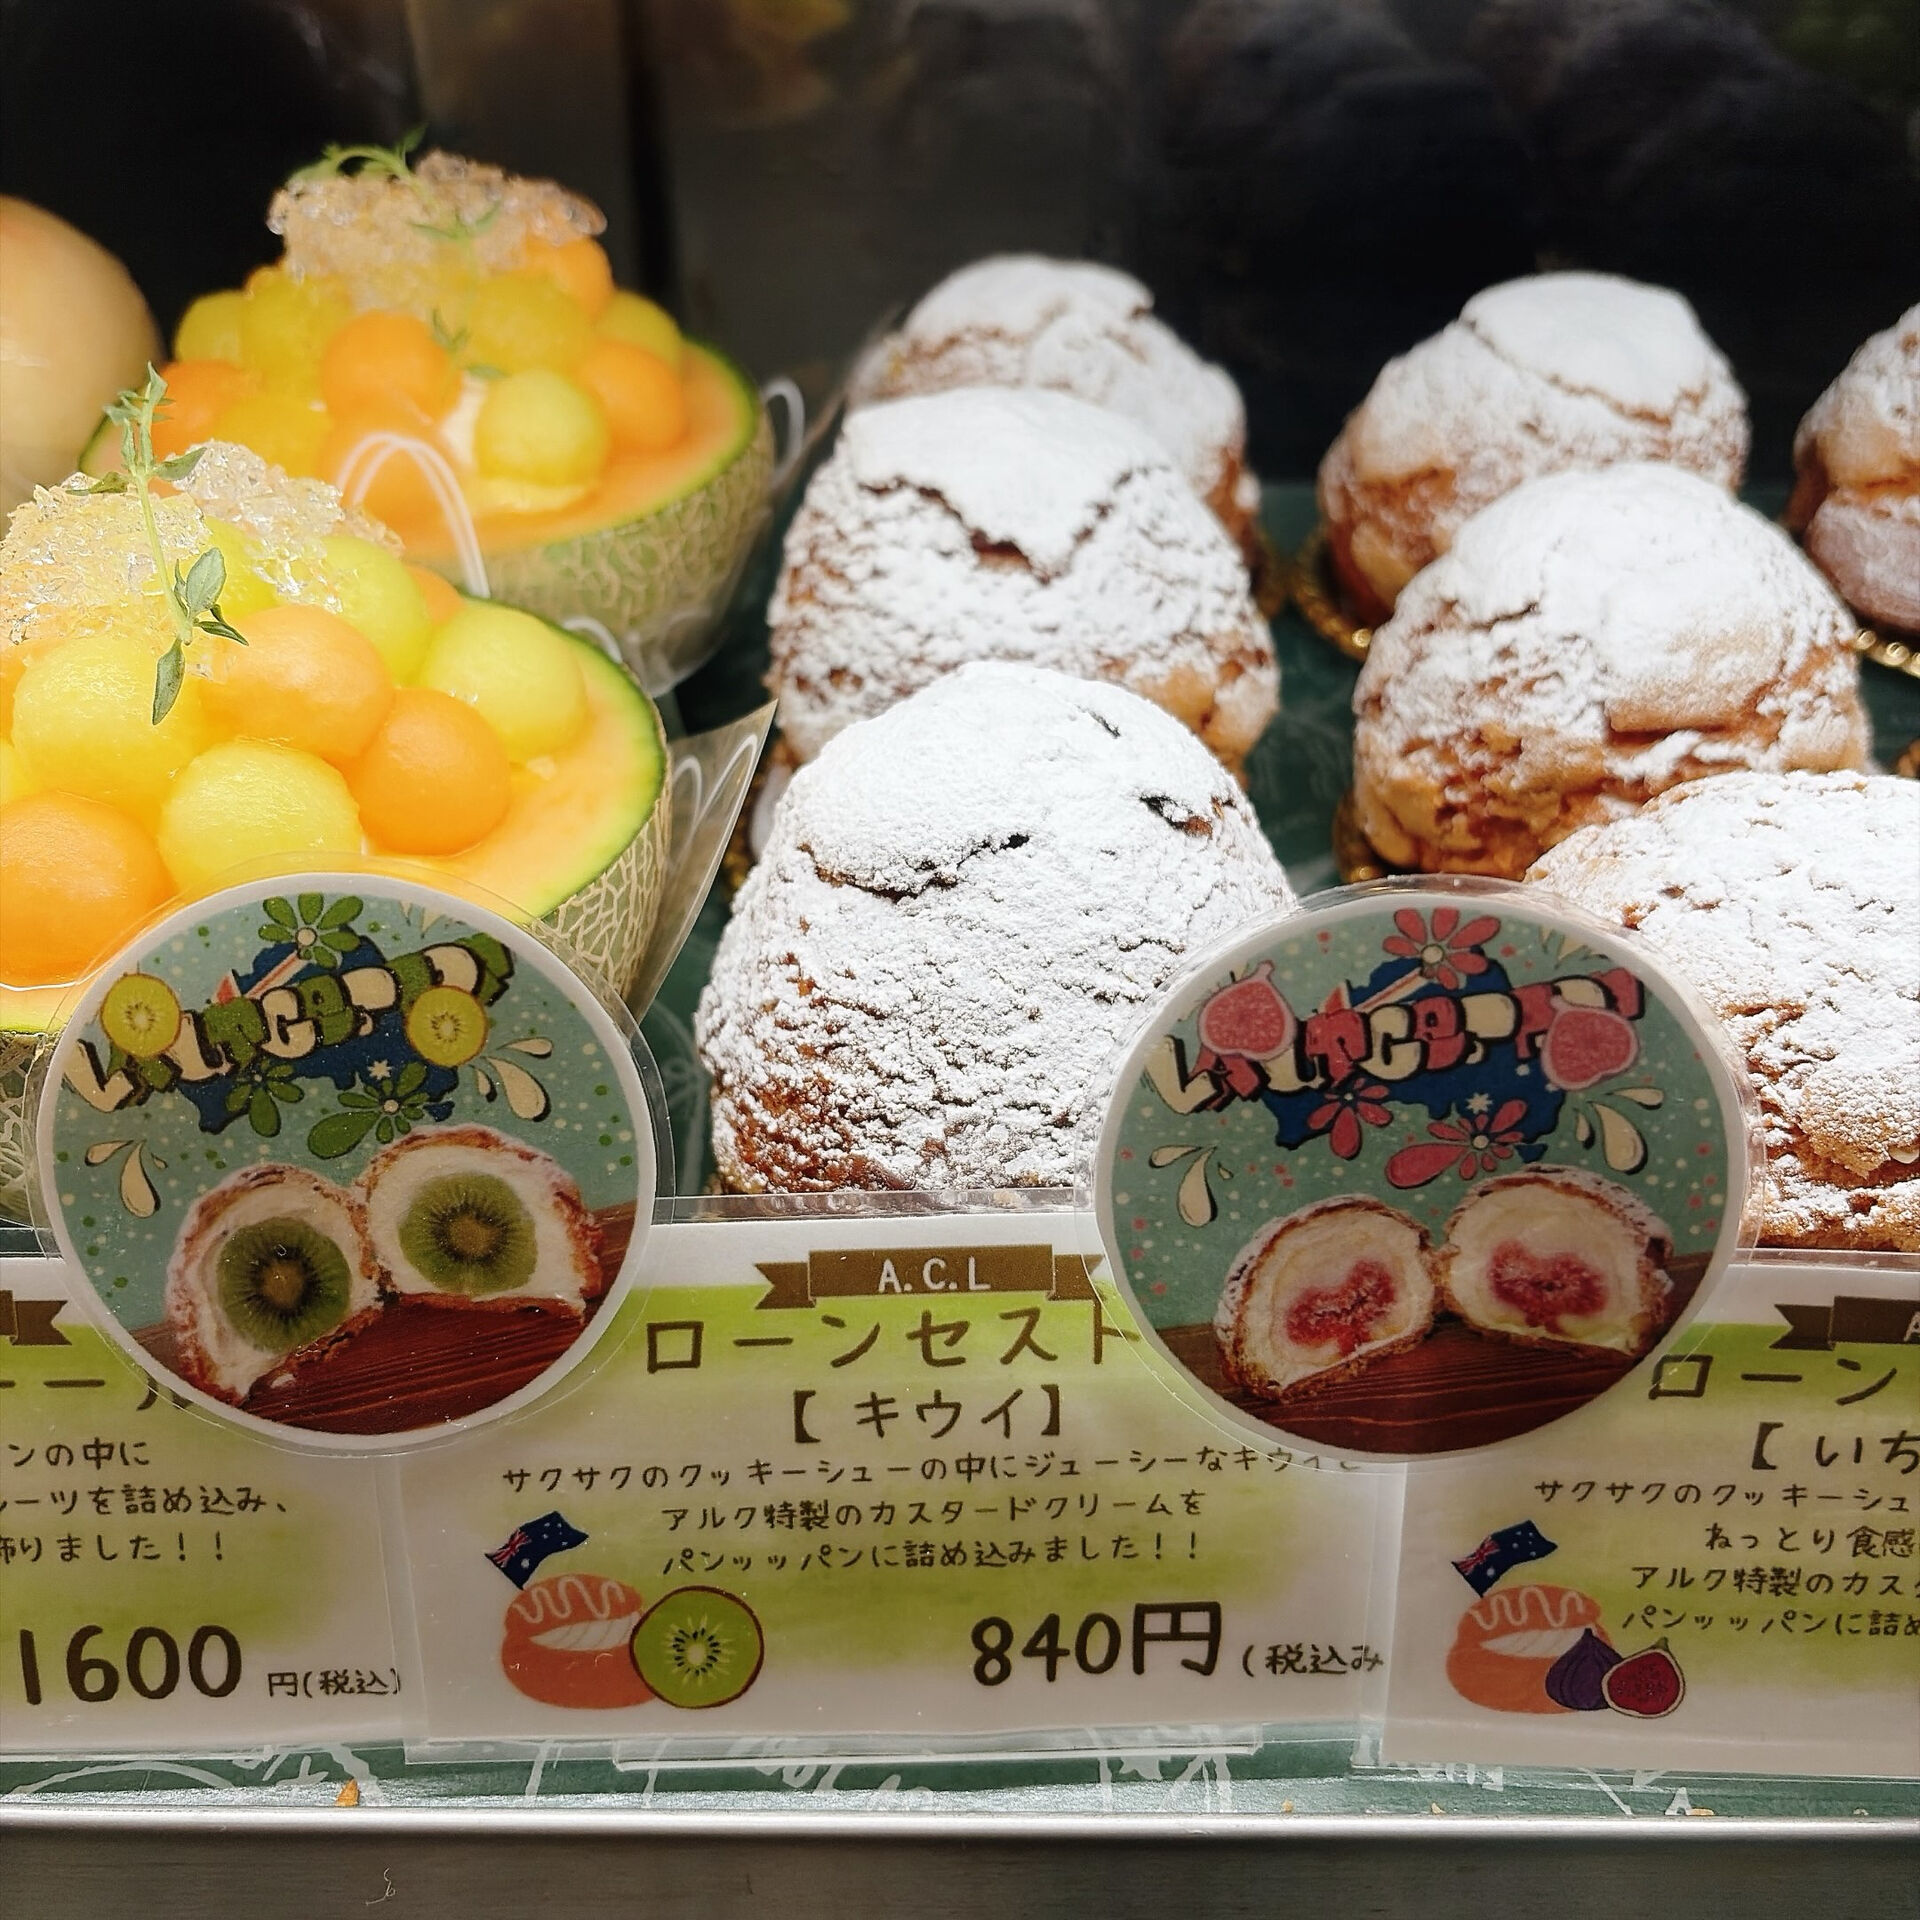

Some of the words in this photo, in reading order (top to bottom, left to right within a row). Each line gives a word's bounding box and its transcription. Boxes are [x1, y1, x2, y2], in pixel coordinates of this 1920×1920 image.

[876, 1256, 992, 1294] A.C.L
[646, 1304, 1141, 1374] ローンセスト
[7, 1436, 150, 1471] ンの中に
[0, 1483, 287, 1516] ーツを詰め込み、
[1631, 1565, 1920, 1598] アルク特製のカス
[971, 1600, 1222, 1687] 840円
[19, 1624, 242, 1706] 1600
